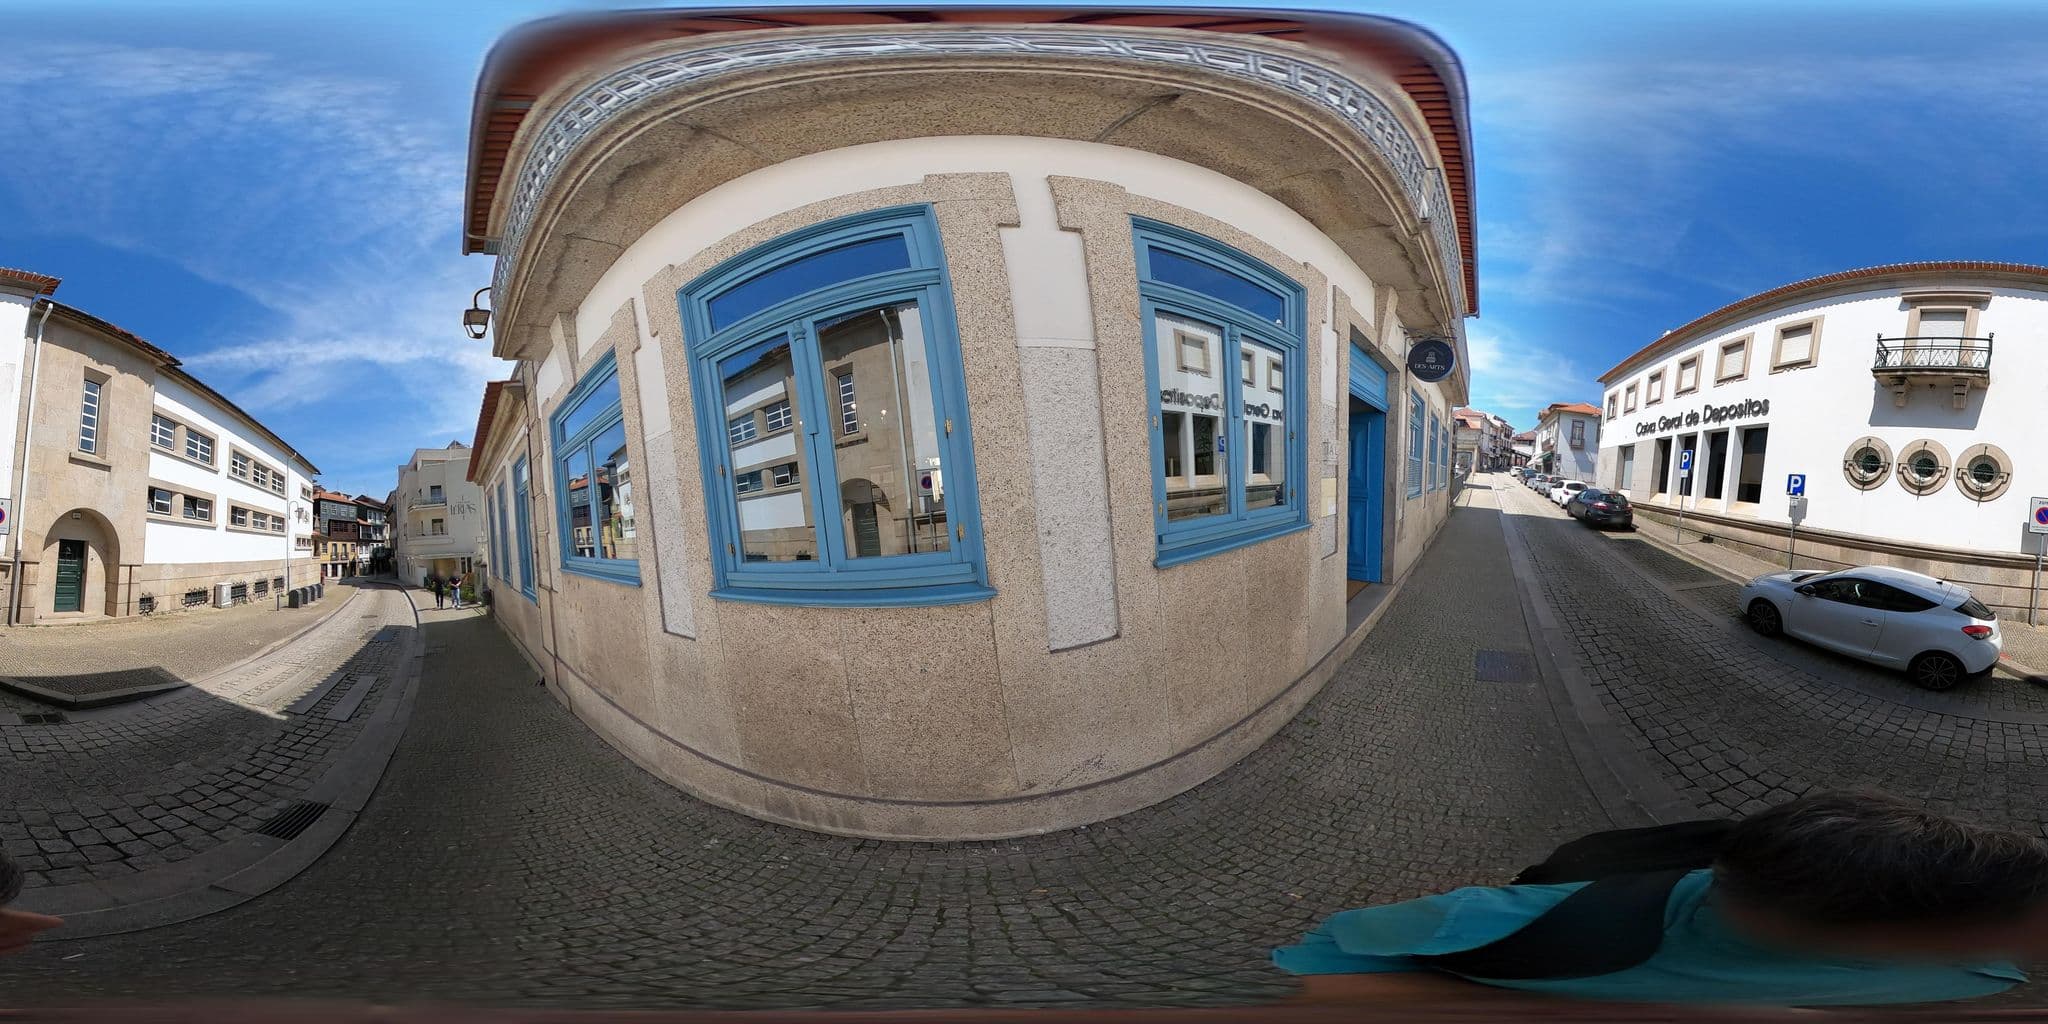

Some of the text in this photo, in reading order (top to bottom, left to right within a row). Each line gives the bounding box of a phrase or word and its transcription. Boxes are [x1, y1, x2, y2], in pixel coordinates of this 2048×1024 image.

[1636, 422, 1656, 437] Caixa
[1658, 411, 1683, 432] Geral
[1685, 409, 1700, 427] de
[1681, 452, 1690, 468] P
[1790, 475, 1802, 494] P
